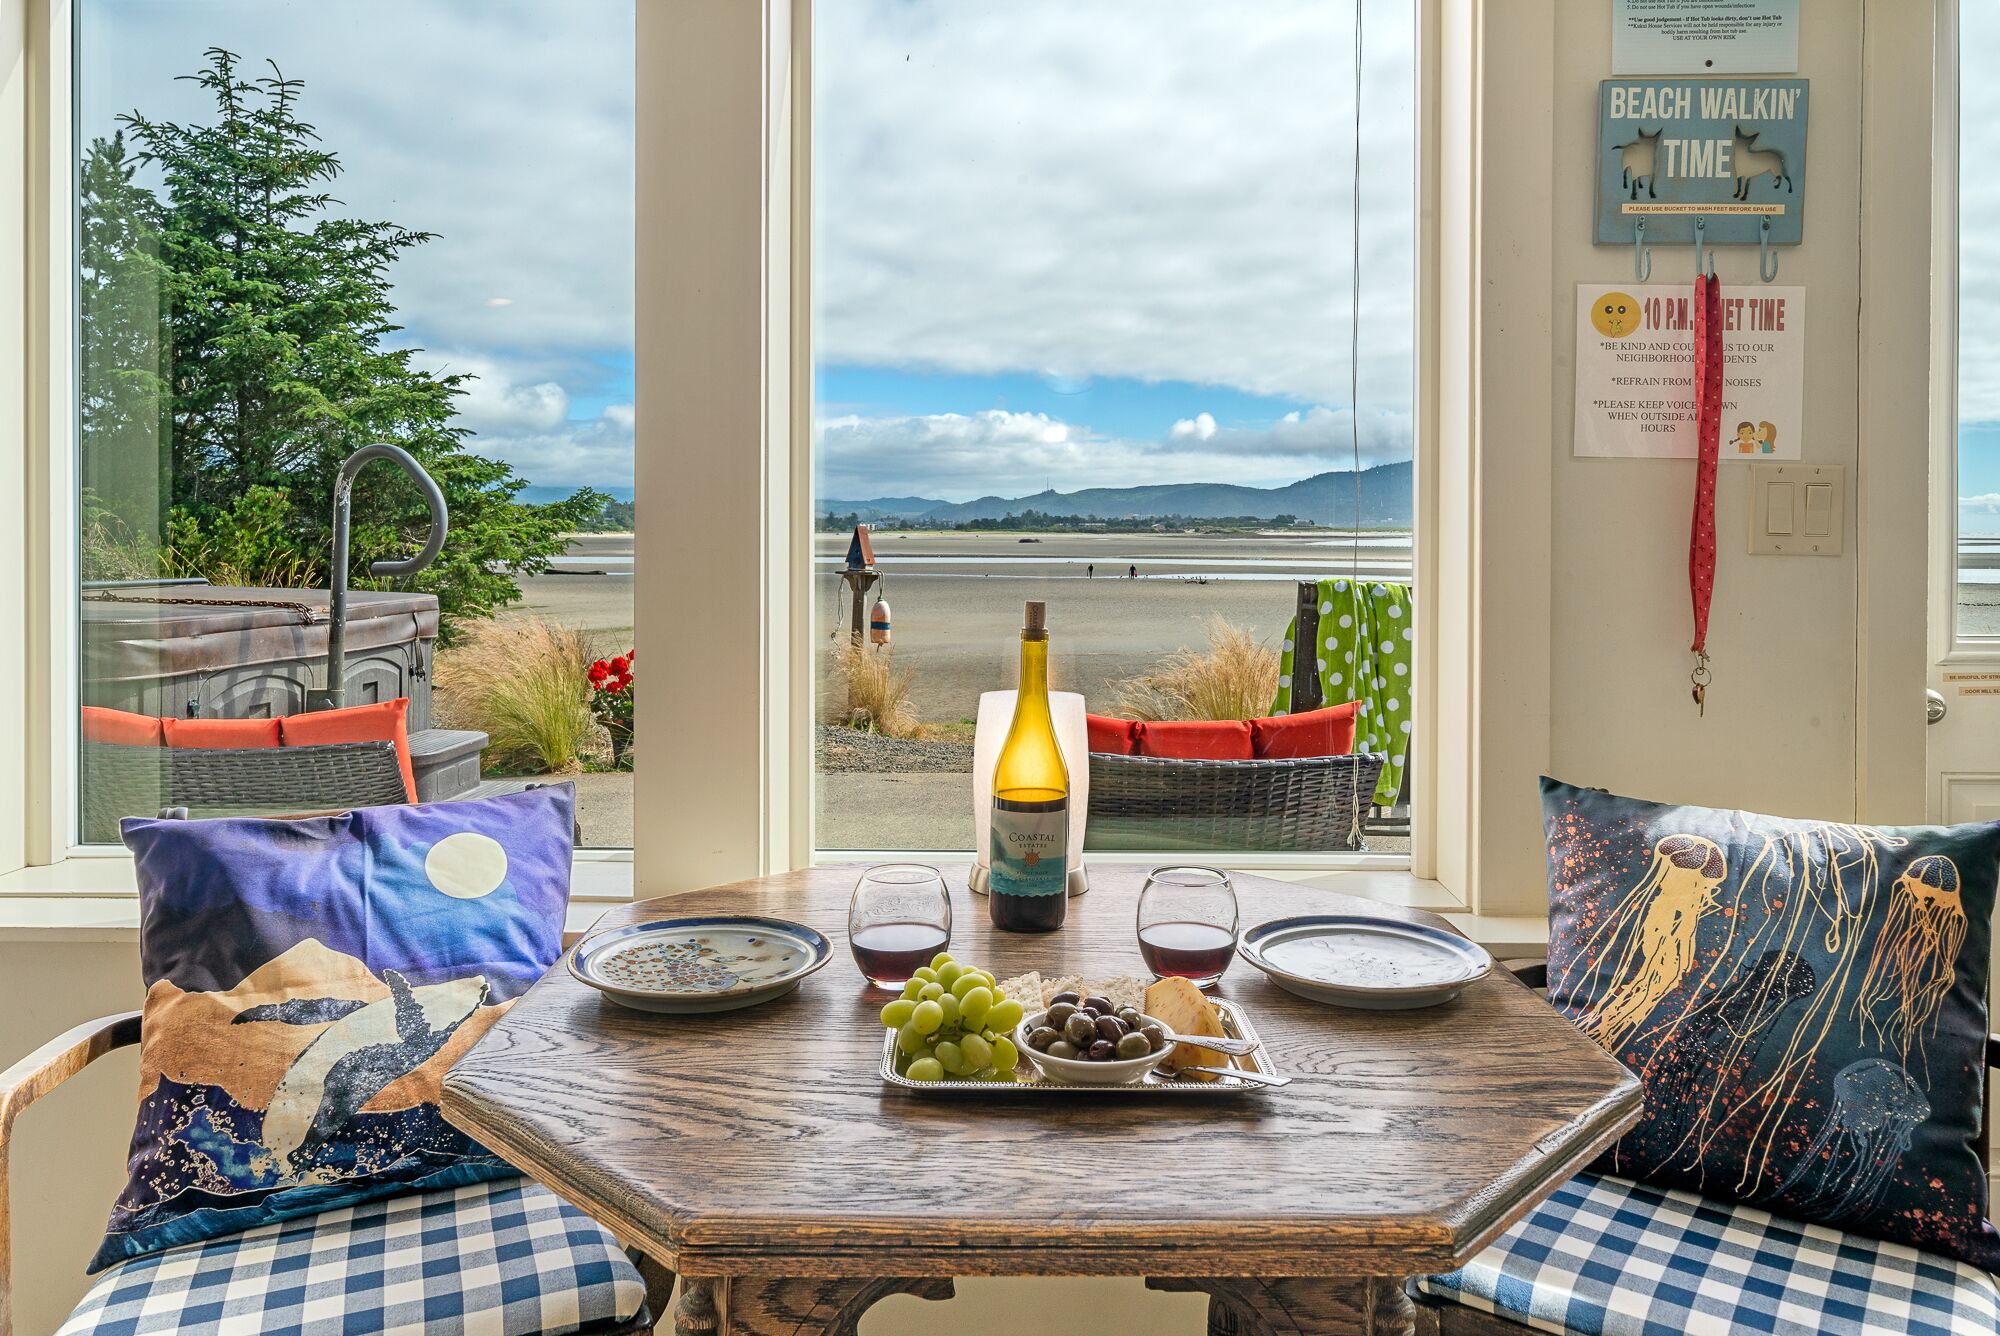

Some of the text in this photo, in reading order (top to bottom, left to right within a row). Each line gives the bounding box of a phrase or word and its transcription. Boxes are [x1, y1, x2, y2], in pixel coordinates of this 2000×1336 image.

[1610, 87, 1801, 120] BEACH WALKIN'
[1663, 139, 1733, 178] TIME
[1644, 297, 1661, 330] 10
[1666, 298, 1694, 330] P.M.
[1749, 298, 1785, 331] TIME
[1620, 342, 1646, 351] KIND
[1648, 343, 1671, 351] AND
[1736, 344, 1750, 352] TO
[1752, 344, 1774, 352] OUR
[1662, 378, 1692, 386] FROM
[1725, 378, 1762, 387] NOISES
[1638, 401, 1664, 409] KEEP
[1607, 412, 1638, 421] WHEN
[1640, 412, 1685, 421] OUTSIDE
[1640, 424, 1676, 433] HOURS
[1008, 832, 1055, 842] COASTAL
